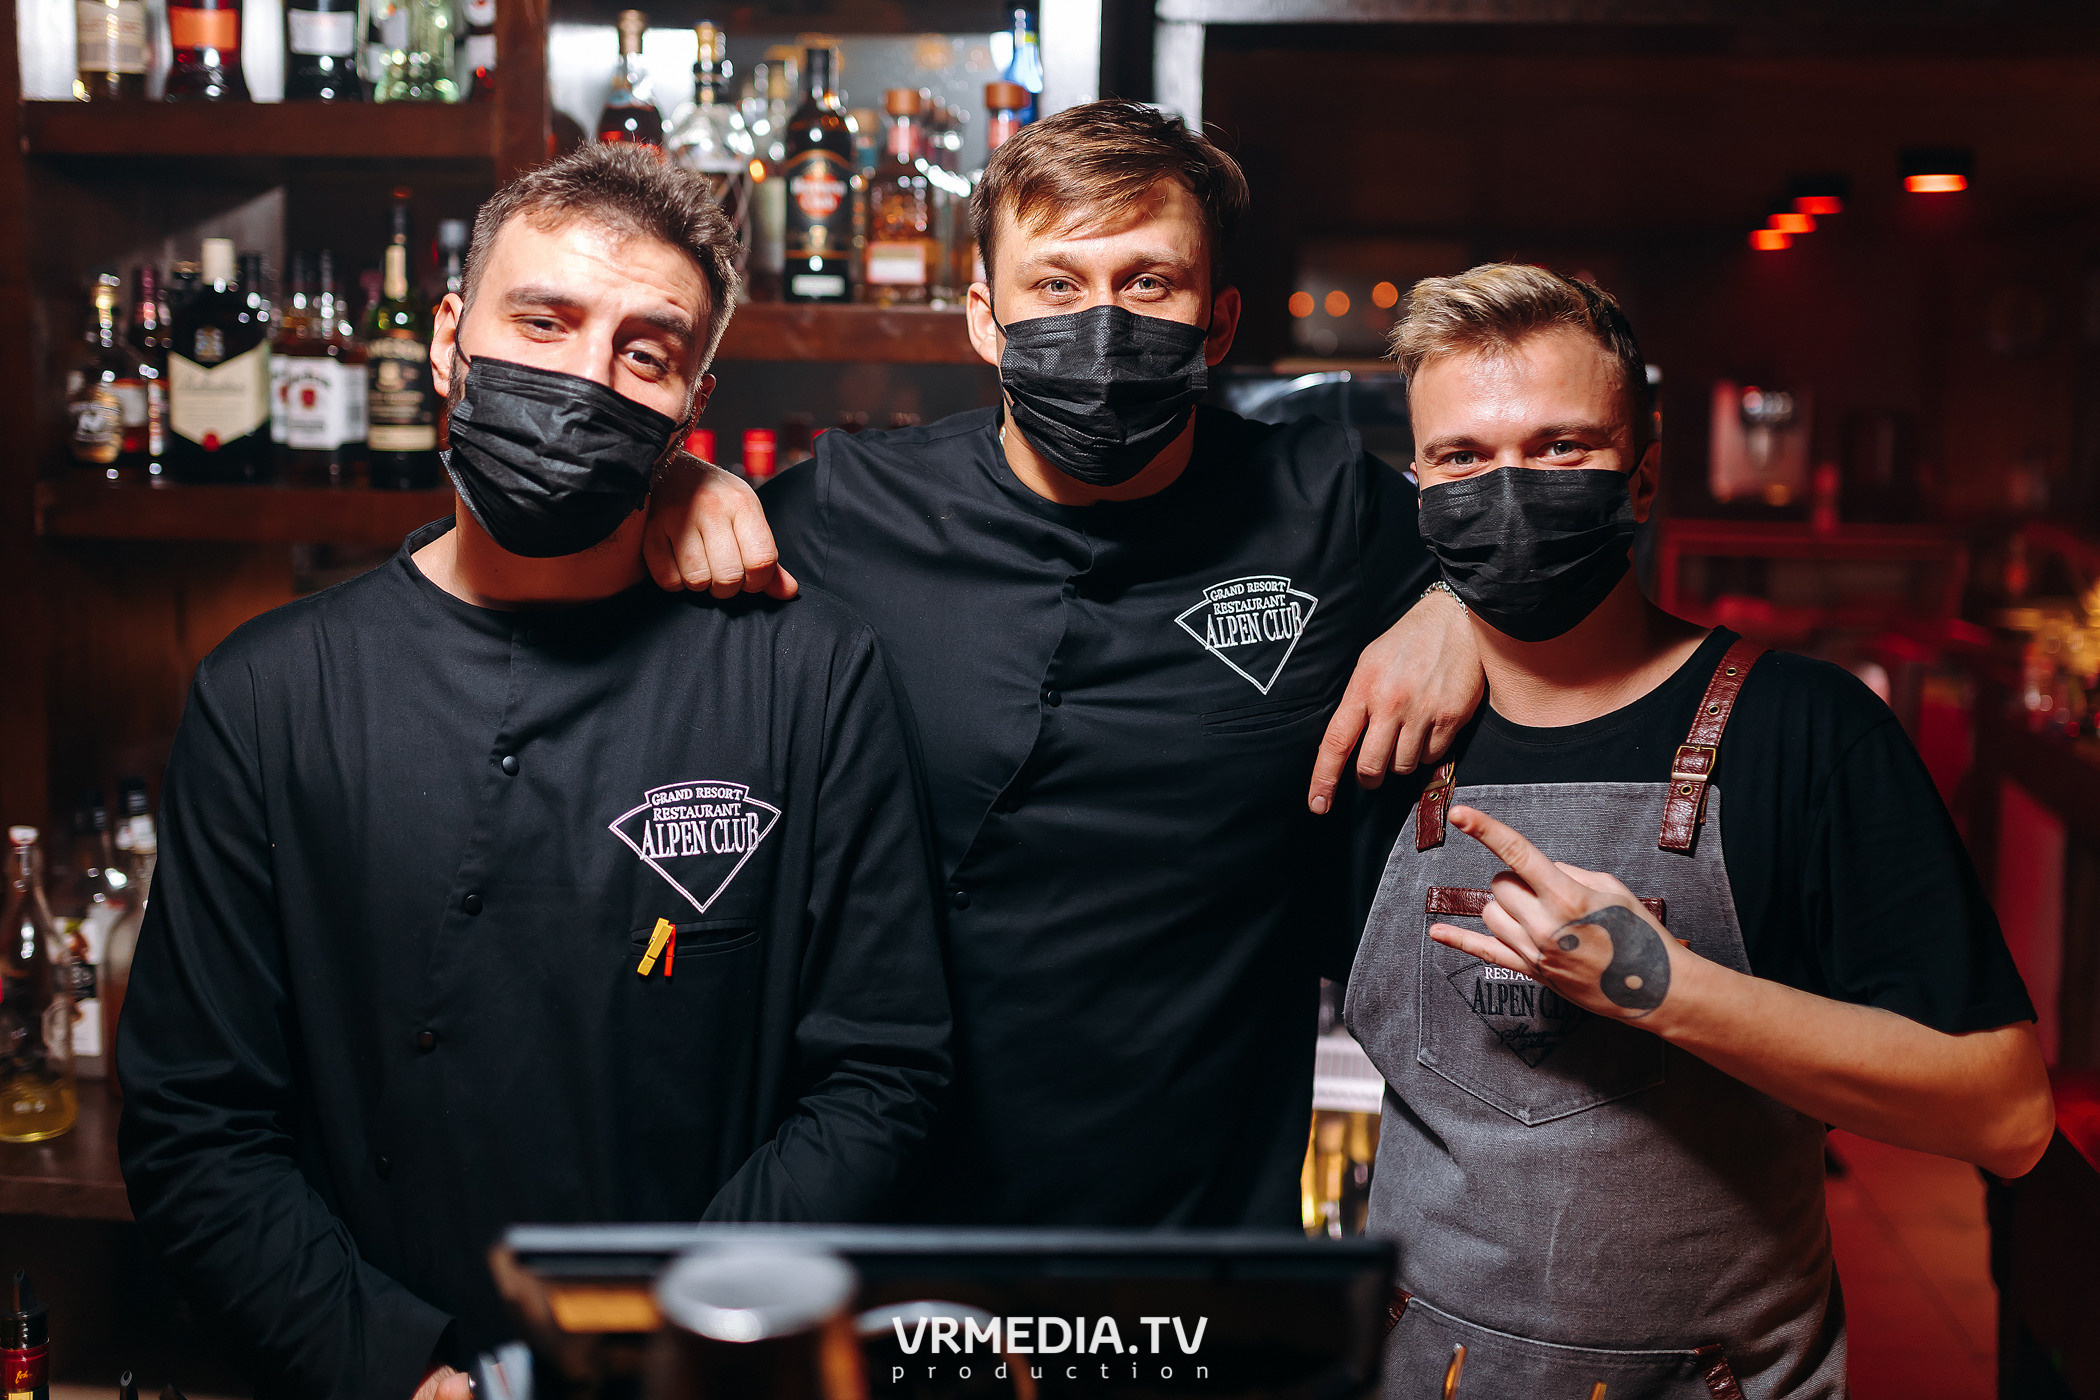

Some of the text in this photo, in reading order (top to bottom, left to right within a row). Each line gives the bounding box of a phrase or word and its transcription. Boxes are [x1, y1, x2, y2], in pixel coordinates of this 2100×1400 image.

[1210, 581, 1287, 602] GRAND RESORT
[1212, 594, 1286, 616] RESTAURANT
[1204, 601, 1304, 650] ALPEN CLUB
[651, 787, 744, 806] GRAND RESORT
[652, 803, 742, 822] RESTAURANT
[639, 812, 760, 861] ALPEN CLUB
[1471, 977, 1537, 1018] ALPEN
